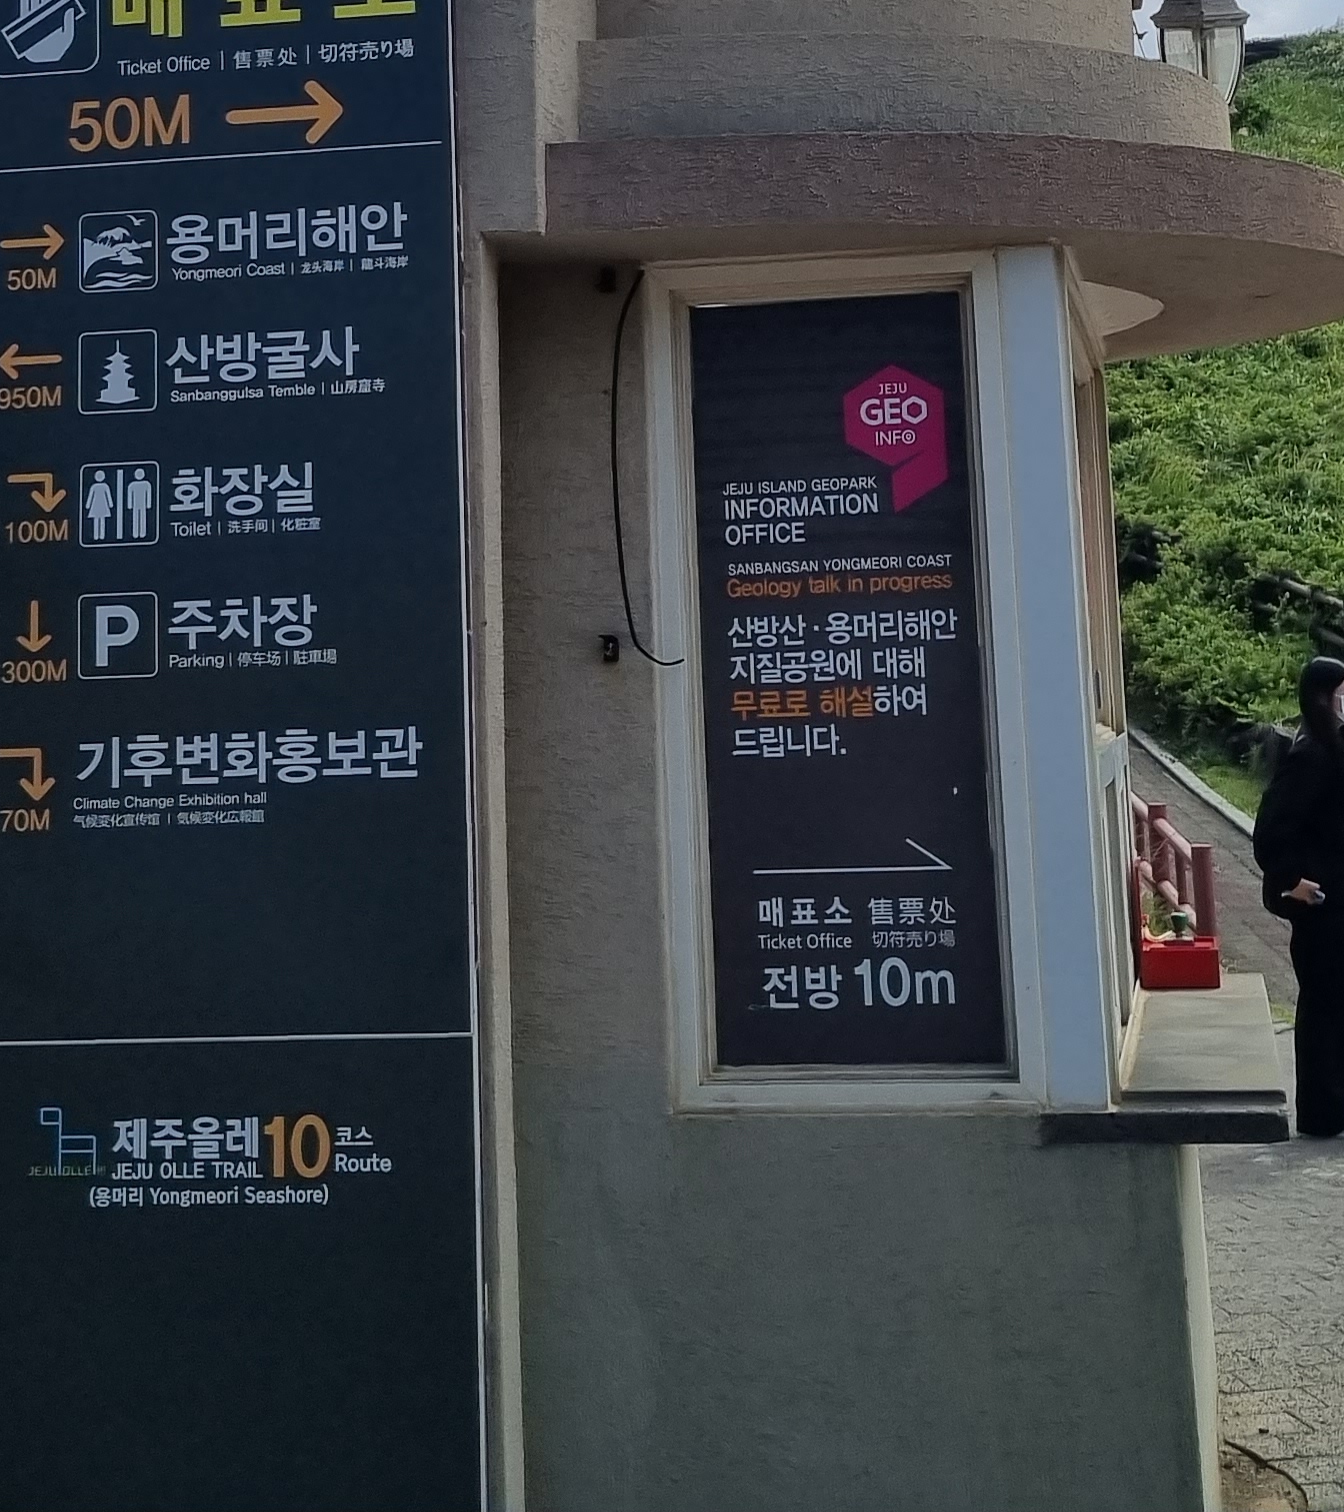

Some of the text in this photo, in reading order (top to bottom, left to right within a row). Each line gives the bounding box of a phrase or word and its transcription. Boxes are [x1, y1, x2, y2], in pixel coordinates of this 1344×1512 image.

[117, 38, 414, 76] Ticket Office 售票处 切符売り場
[68, 94, 190, 152] 50M
[166, 201, 408, 265] 용머리해안
[7, 268, 57, 292] 50M
[172, 264, 242, 282] Yongmeori
[246, 262, 286, 277] Coast
[165, 326, 359, 385] 산방굴사
[170, 388, 264, 403] Sanbanggulsa
[268, 383, 315, 397] Temble
[878, 383, 907, 395] JEJU
[860, 395, 928, 426] GEO
[875, 430, 916, 446] INFO
[169, 461, 315, 517] 화장실
[723, 476, 878, 496] JEJU ISLAND GEOPARK
[724, 492, 879, 521] INFORMATION
[5, 519, 68, 544] 100M
[170, 521, 212, 537] Toilet
[227, 519, 268, 534] 洗手间
[725, 522, 806, 546] OFFICE
[728, 554, 953, 577] SANBANGSAN YONGMEORI COAST
[727, 572, 953, 599] Geology talk in progress
[168, 593, 318, 650] 주차장
[727, 608, 957, 648] 산방산 용머리해안
[95, 605, 140, 668] P
[1, 659, 67, 685] 300M
[168, 653, 224, 669] Parking
[237, 650, 281, 667] 停车场
[730, 646, 926, 685] 지질공원에 대해
[731, 684, 927, 720] 무료로 해설하여
[732, 724, 847, 758] 드립니다.
[76, 725, 423, 788] 기후변화홍보관
[73, 791, 267, 810] Climate Change Exhibition hall
[0, 808, 50, 833] 70M
[758, 896, 853, 927] 매표소
[867, 896, 956, 926] 售票处
[758, 933, 852, 950] Ticket Office
[872, 929, 955, 949] 切符売り場
[762, 956, 955, 1010] 전방 10m
[111, 1114, 331, 1179] 제주올레 10
[335, 1126, 374, 1146] 코스
[111, 1163, 153, 1180] JEJU
[160, 1162, 205, 1180] OLLE
[210, 1161, 263, 1180] TRAIL
[335, 1152, 392, 1173] Route
[89, 1183, 329, 1208] (용머리 Yongmeori Seashore)
